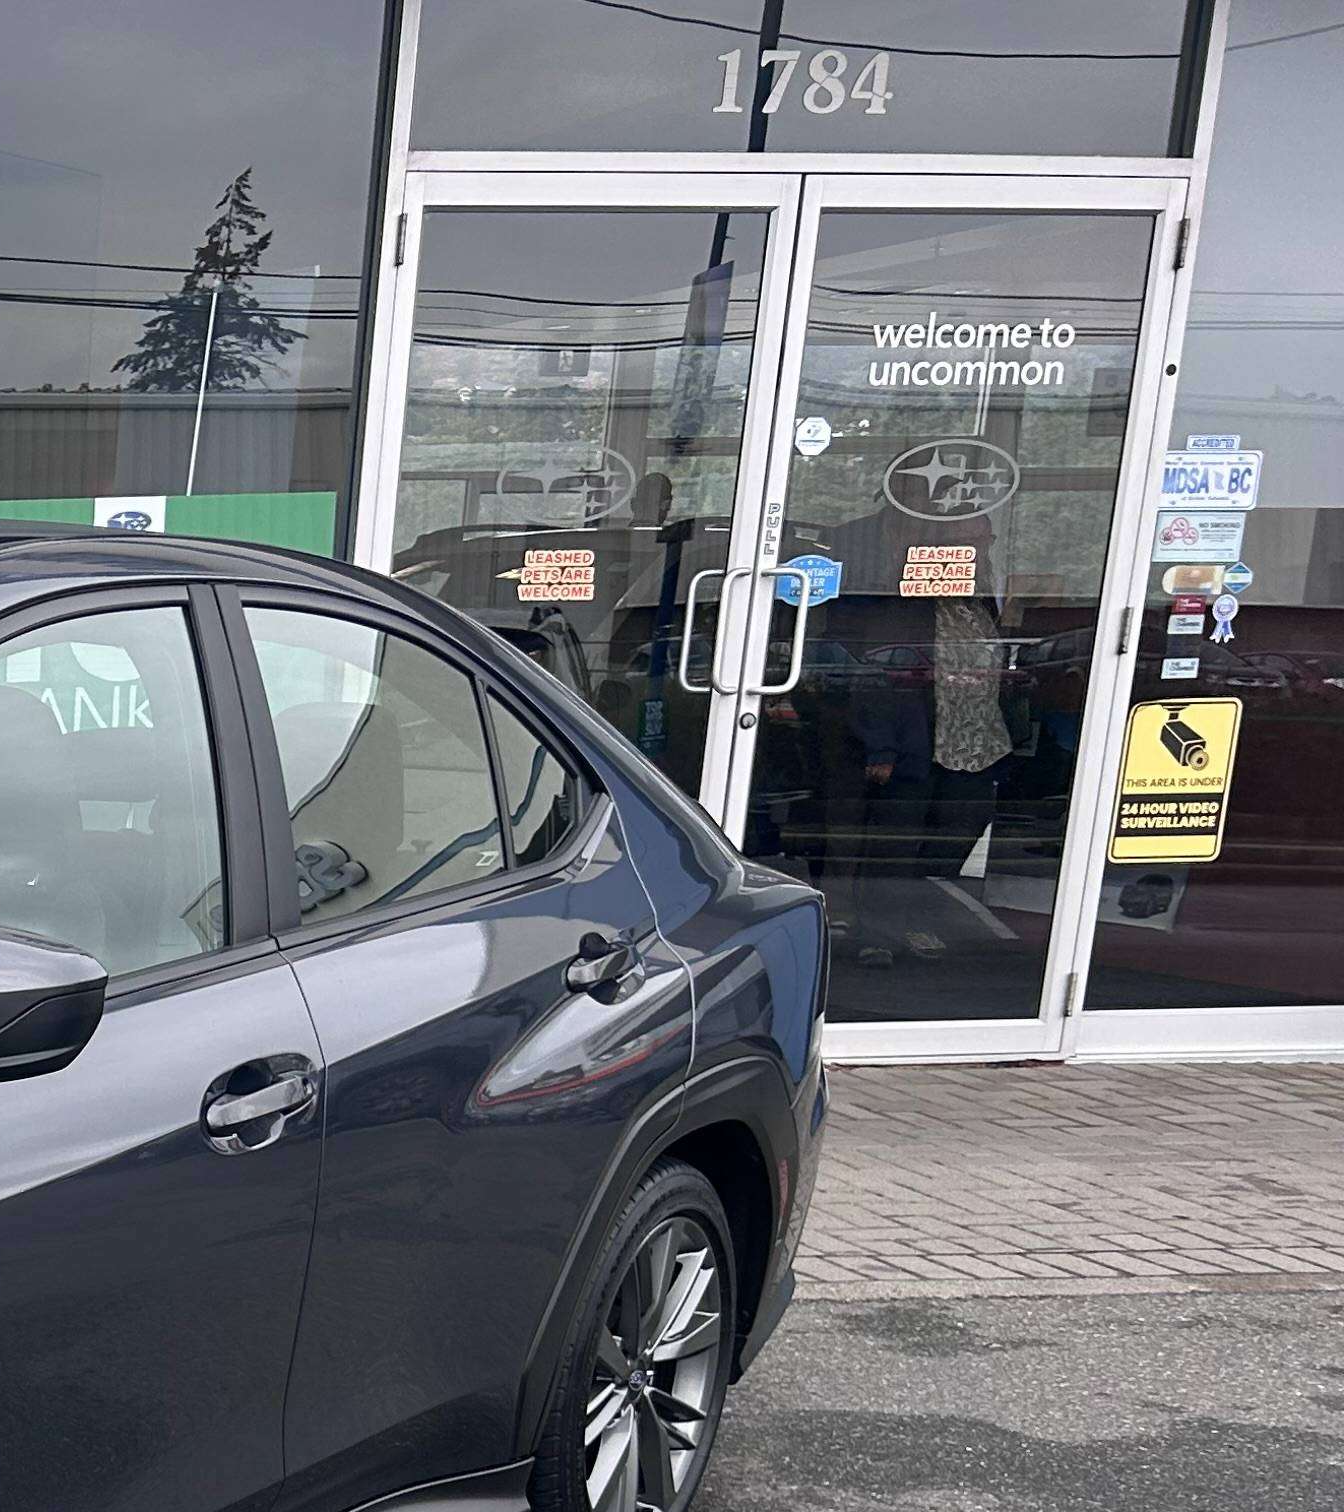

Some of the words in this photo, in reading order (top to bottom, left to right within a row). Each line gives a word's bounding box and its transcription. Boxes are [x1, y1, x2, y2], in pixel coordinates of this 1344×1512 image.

[713, 49, 893, 114] 1784
[873, 312, 1032, 348] welcome
[1039, 318, 1075, 348] to
[869, 361, 1064, 386] uncommon
[1162, 468, 1209, 494] MDSA
[1228, 468, 1252, 494] BC
[764, 503, 780, 555] PULL
[527, 553, 592, 564] LEASHED
[910, 549, 973, 560] LEASHED
[524, 570, 559, 581] PETS
[564, 569, 591, 581] ARE
[906, 566, 941, 577] PETS
[946, 565, 973, 576] ARE
[521, 586, 591, 597] WELCOME
[903, 582, 972, 594] WELCOME
[1126, 778, 1148, 788] THIS
[1150, 778, 1176, 788] AREA
[1178, 777, 1188, 787] IS
[1190, 777, 1223, 787] UNDER
[1120, 803, 1139, 815] 24
[1139, 803, 1178, 815] HOUR
[1179, 802, 1220, 814] VIDEO
[1120, 815, 1216, 829] SURVEILLANCE
